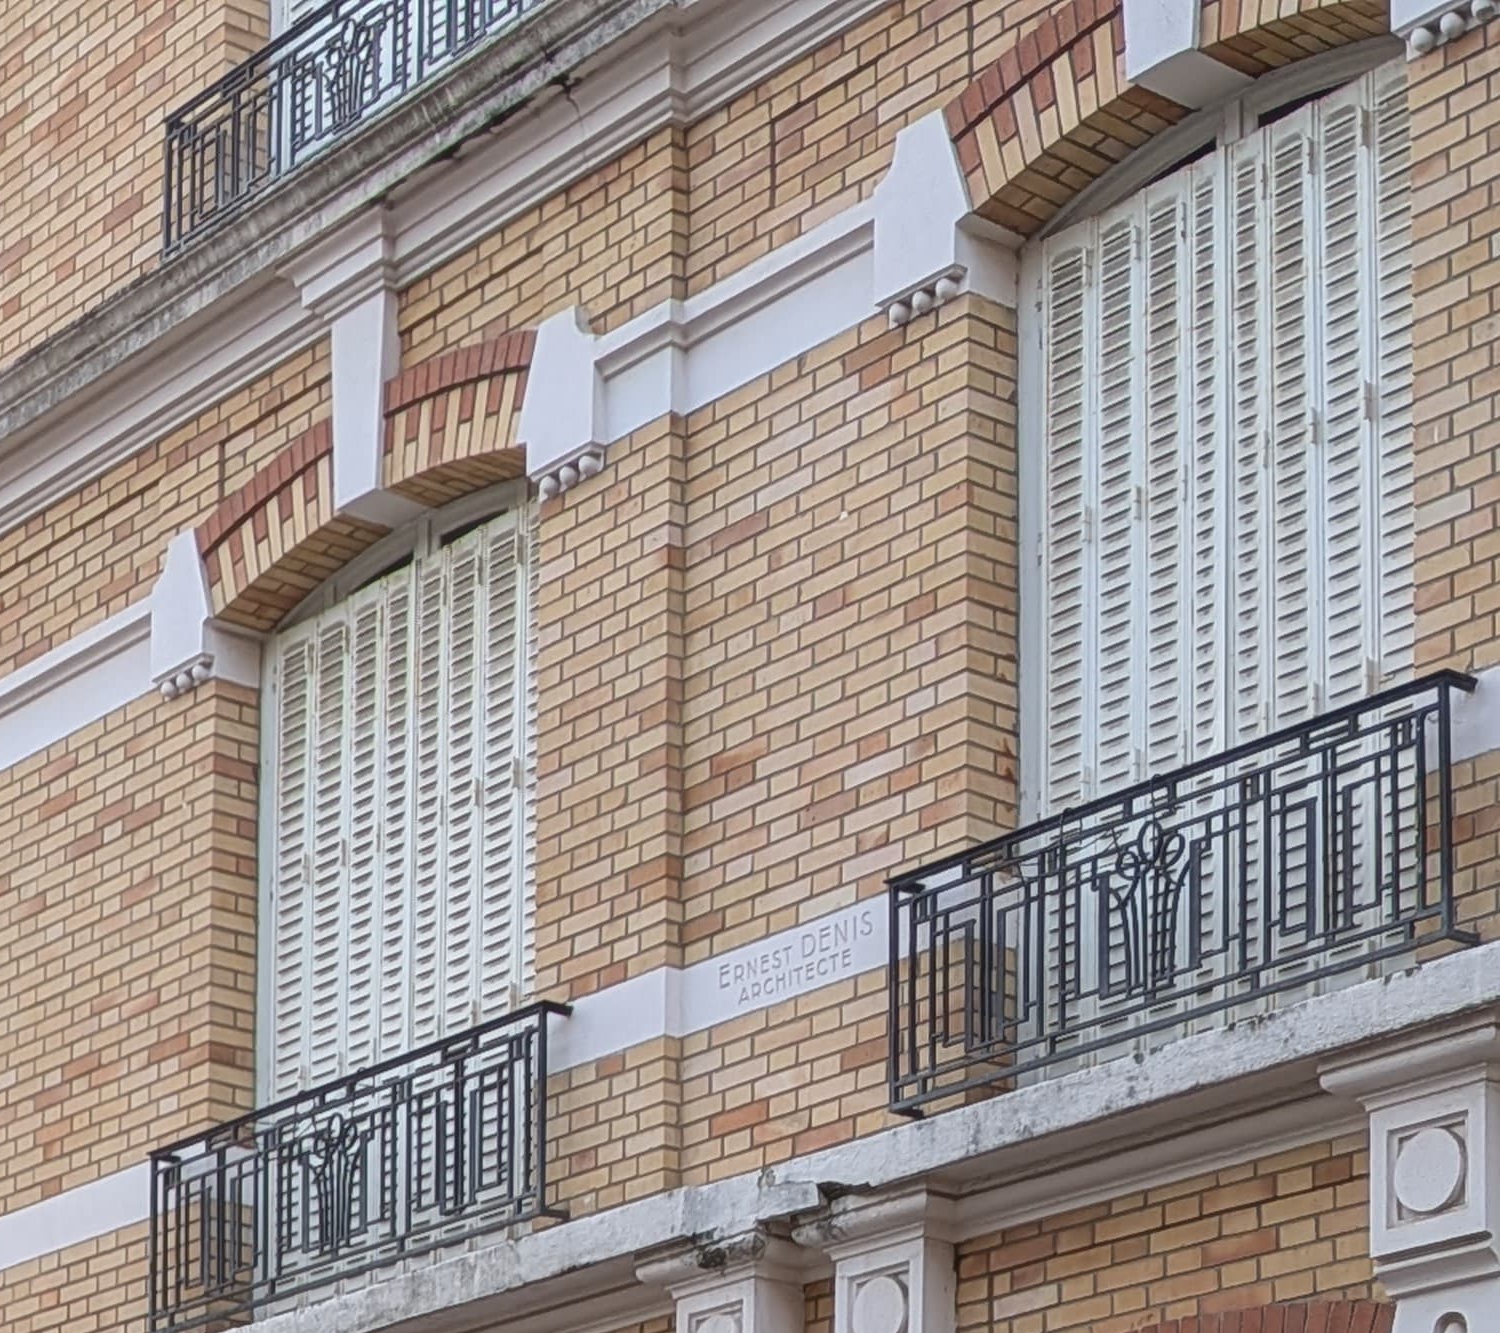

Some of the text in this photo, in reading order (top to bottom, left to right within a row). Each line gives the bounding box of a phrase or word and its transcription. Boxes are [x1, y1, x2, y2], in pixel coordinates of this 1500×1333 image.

[718, 910, 874, 990] ERNEST DENIS
[737, 948, 852, 1006] ARCHITECTE
